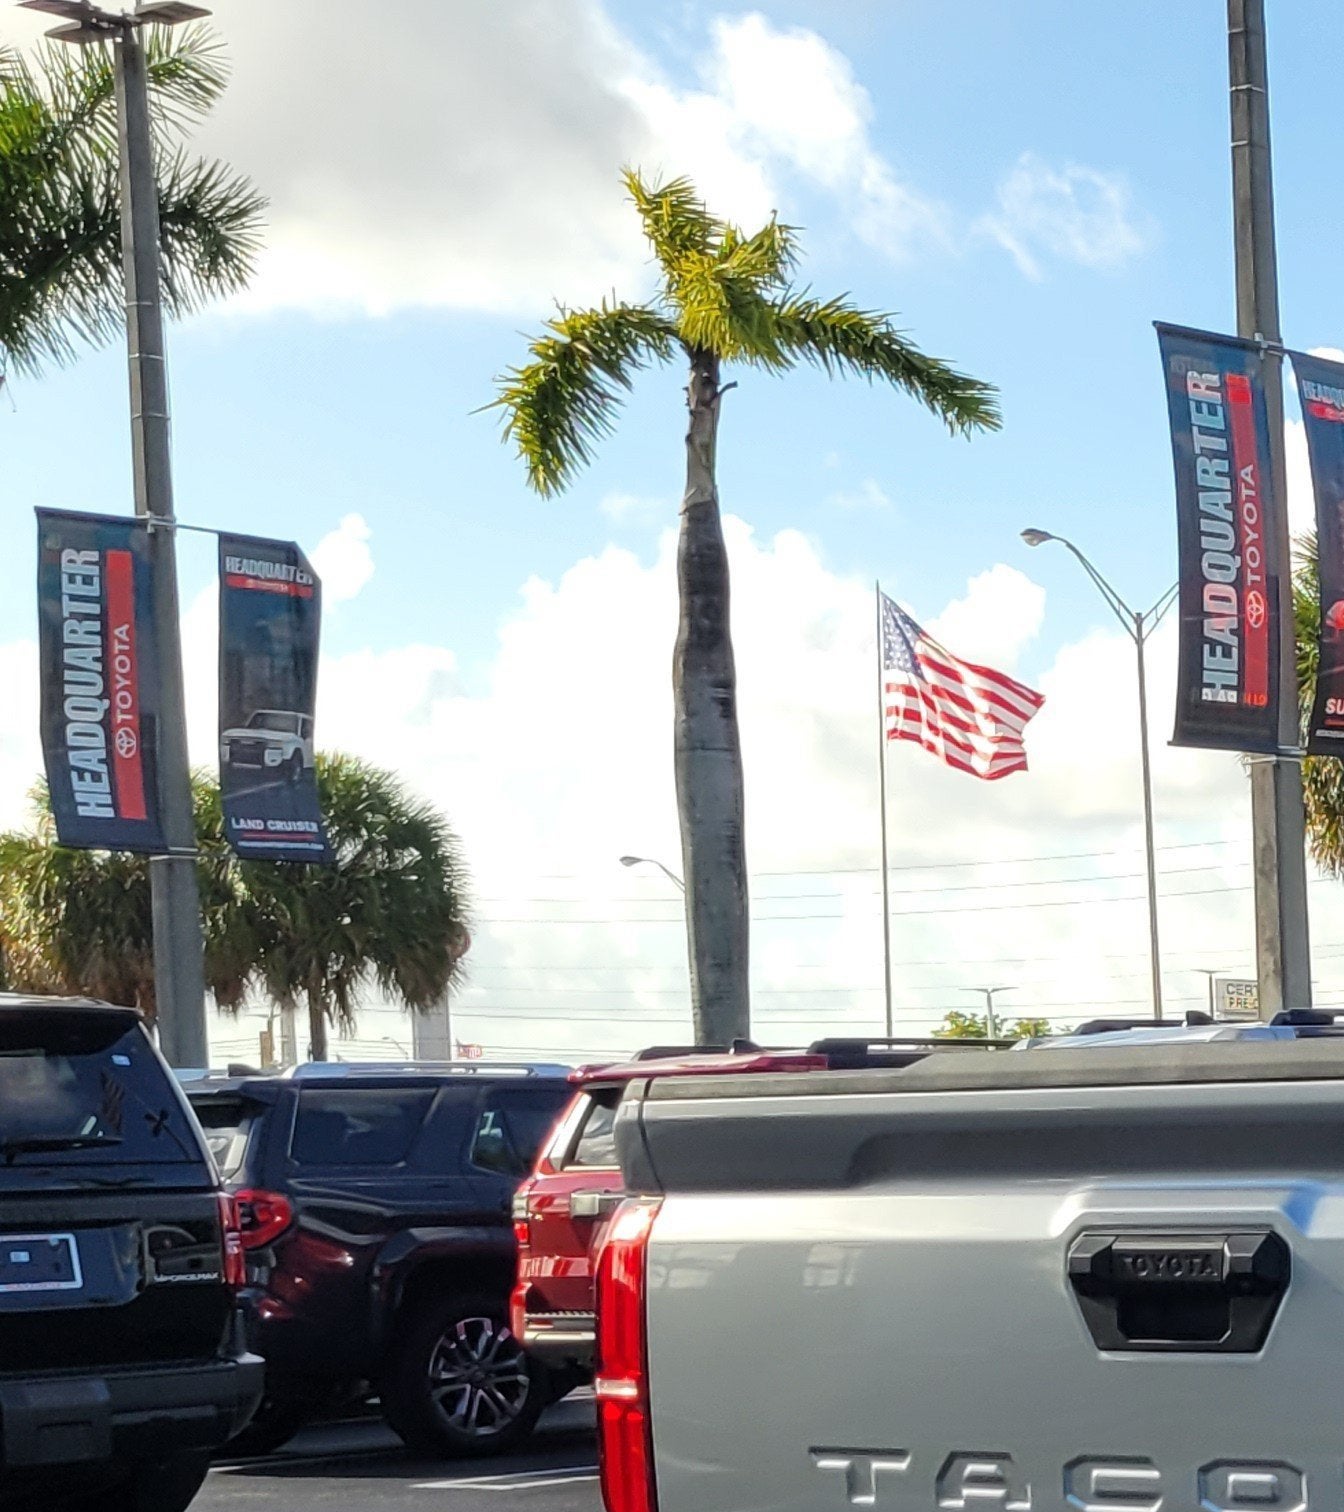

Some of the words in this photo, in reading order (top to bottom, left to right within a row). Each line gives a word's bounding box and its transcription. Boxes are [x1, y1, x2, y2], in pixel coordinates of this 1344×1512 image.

[1186, 370, 1239, 703] HEADQUARTER
[1239, 463, 1265, 587] TOYOTA
[61, 547, 115, 819] HEADQUARTER
[113, 623, 135, 724] TOYOTA
[231, 817, 264, 830] LAND
[1121, 1253, 1219, 1278] TOYOTA
